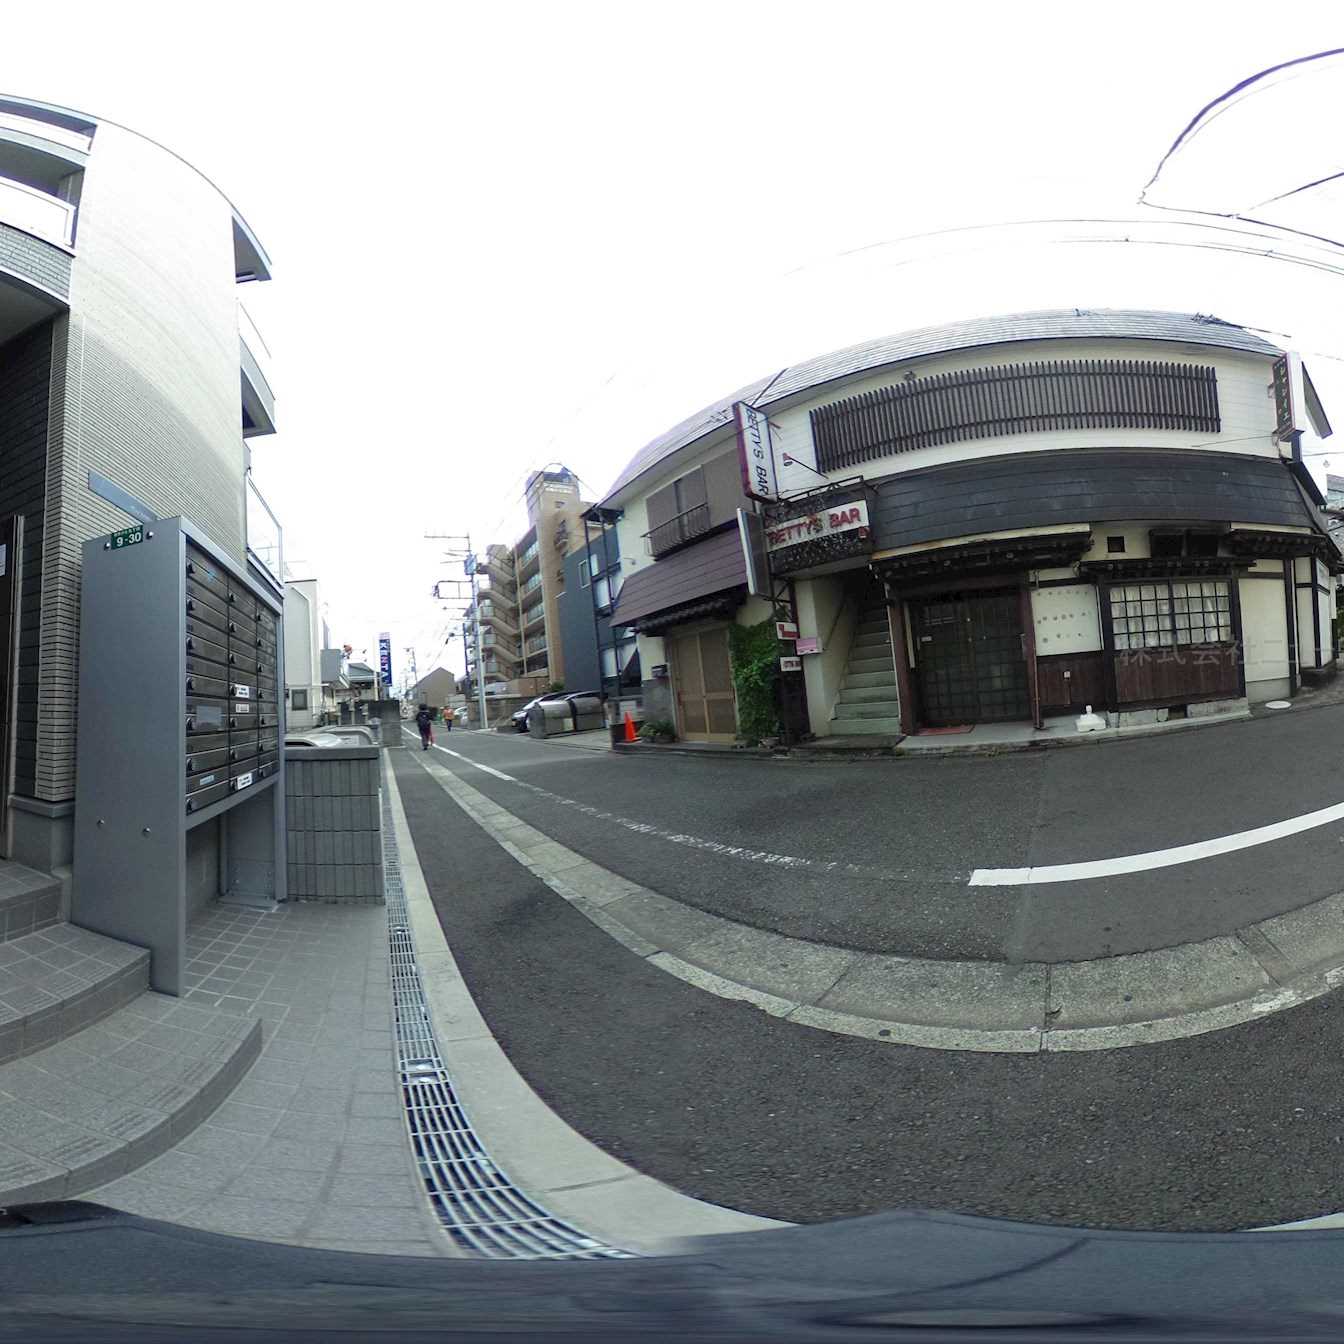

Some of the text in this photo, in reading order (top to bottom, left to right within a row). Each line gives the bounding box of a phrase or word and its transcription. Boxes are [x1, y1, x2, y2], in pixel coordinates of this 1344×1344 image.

[756, 465, 769, 495] BAR
[829, 508, 861, 529] BAR
[116, 532, 142, 547] 9-30
